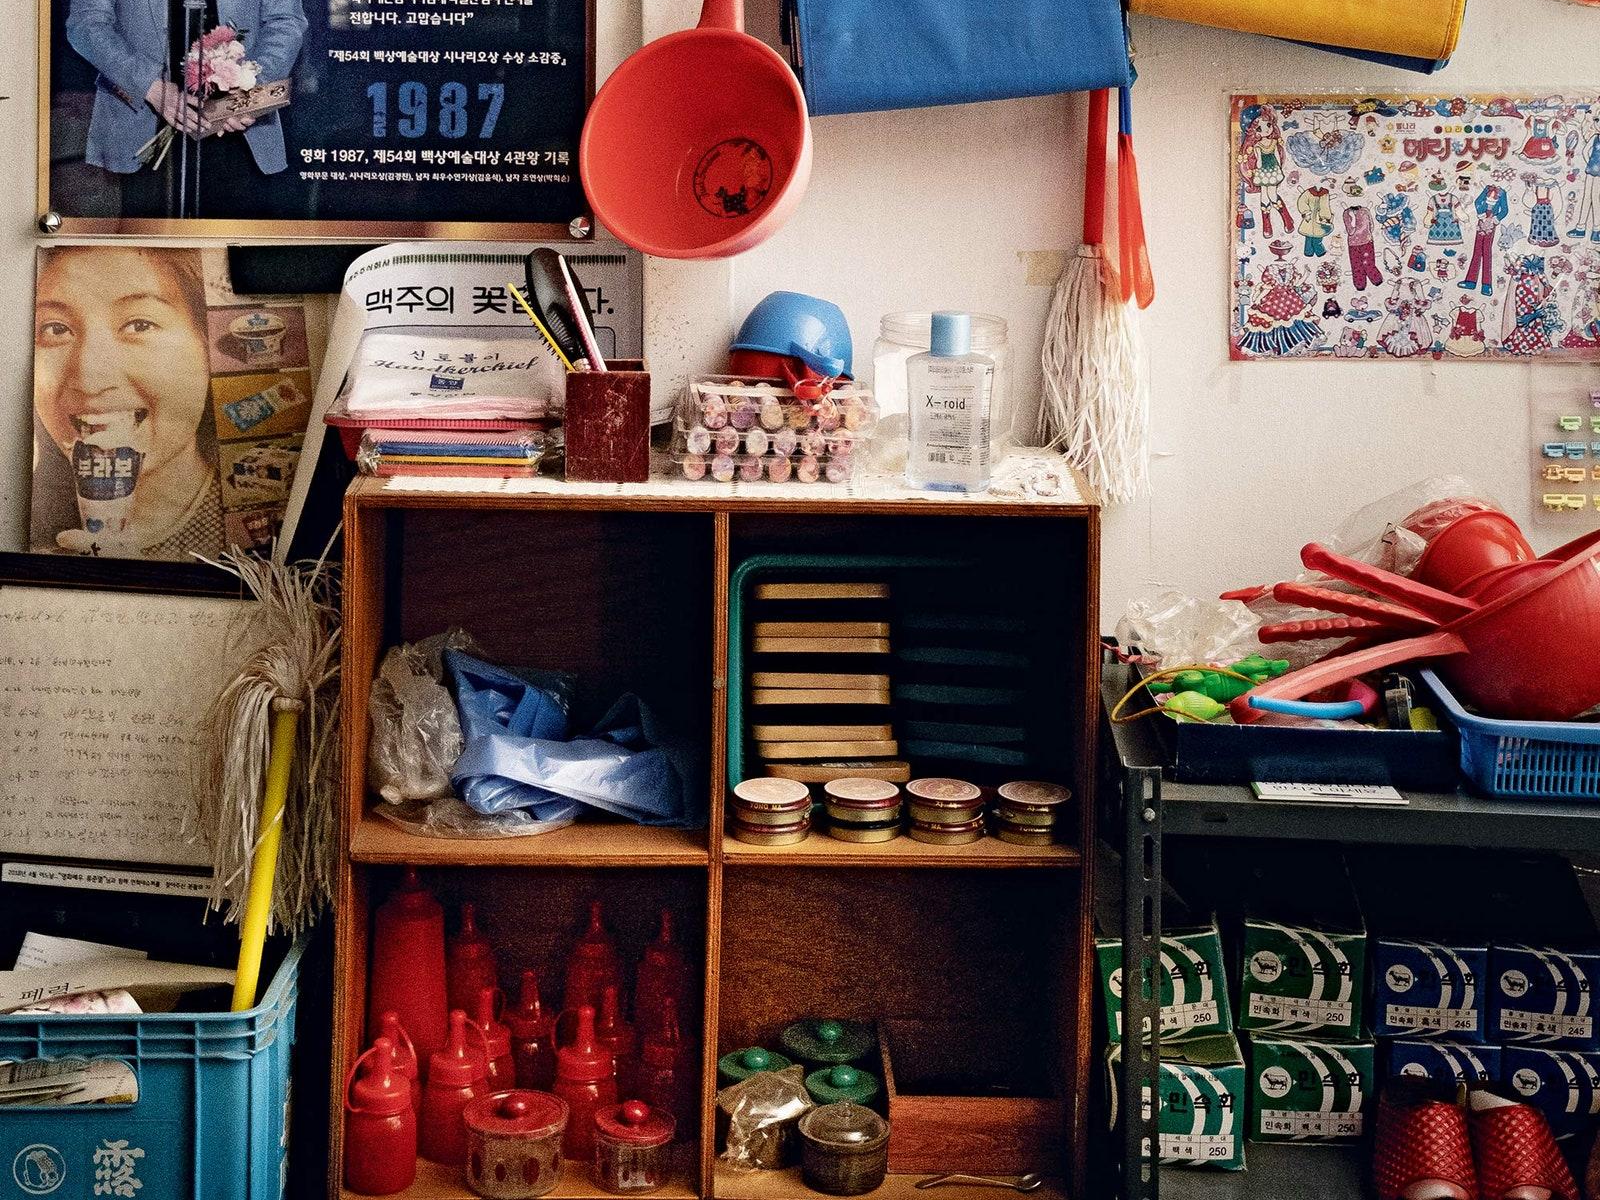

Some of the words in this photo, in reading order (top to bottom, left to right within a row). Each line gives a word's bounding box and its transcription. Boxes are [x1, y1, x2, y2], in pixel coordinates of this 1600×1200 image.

[349, 11, 402, 25] 전합니다.
[405, 12, 474, 26] 고맙습니다”
[373, 50, 440, 63] 백상예술대상
[443, 51, 500, 64] 시나리오상
[502, 51, 525, 64] 수상
[367, 81, 505, 139] 1987
[300, 148, 327, 163] 영화
[331, 149, 369, 164] 1987,
[373, 149, 417, 164] 제54회
[421, 149, 500, 165] 백상예술대상
[503, 151, 540, 165] 4관왕
[544, 152, 570, 166] 기록
[365, 286, 454, 315] 맥주의
[472, 286, 615, 315] 꽃다.
[369, 356, 538, 375] Handkerchief
[1193, 1013, 1212, 1023] 250
[1326, 1013, 1344, 1022] 250
[1454, 1020, 1472, 1029] 245
[1568, 1027, 1586, 1036] 245
[1169, 1091, 1236, 1114] 민속화
[1337, 1123, 1356, 1133] 250
[1208, 1146, 1227, 1157] 250
